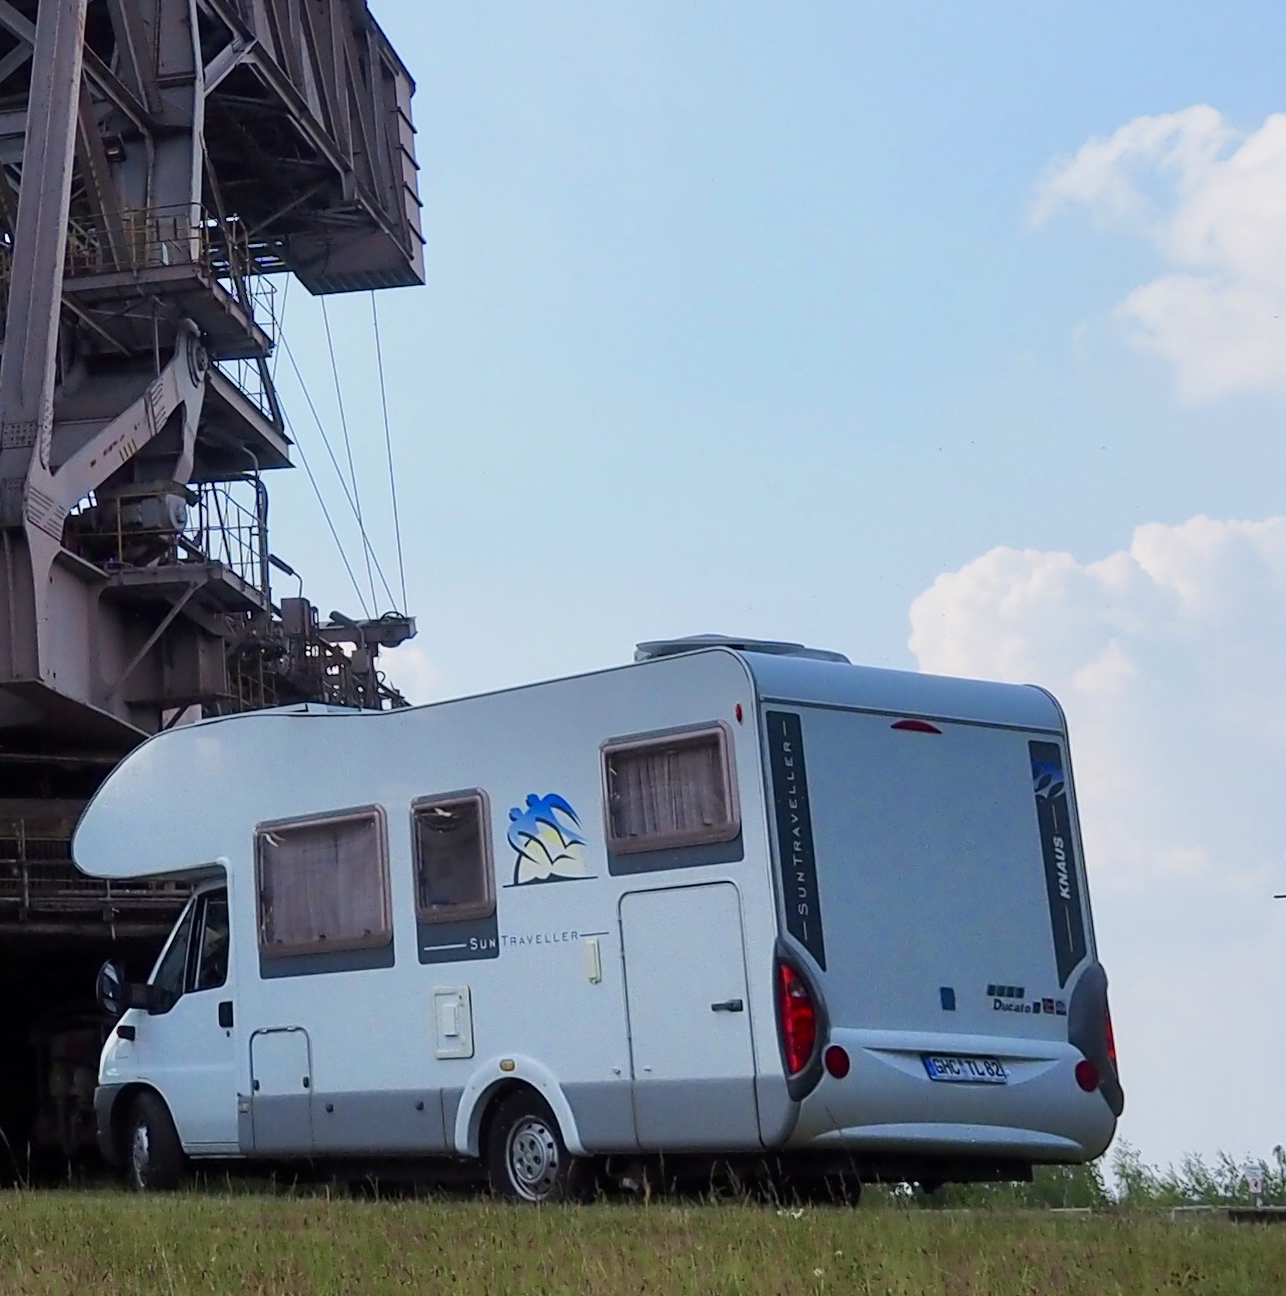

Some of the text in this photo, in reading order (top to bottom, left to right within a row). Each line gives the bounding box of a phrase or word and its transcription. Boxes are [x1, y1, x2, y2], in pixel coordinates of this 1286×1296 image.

[1053, 836, 1071, 899] KNAUS
[993, 998, 1031, 1013] Ducato
[932, 1058, 960, 1074] GHC
[964, 1060, 985, 1076] TL
